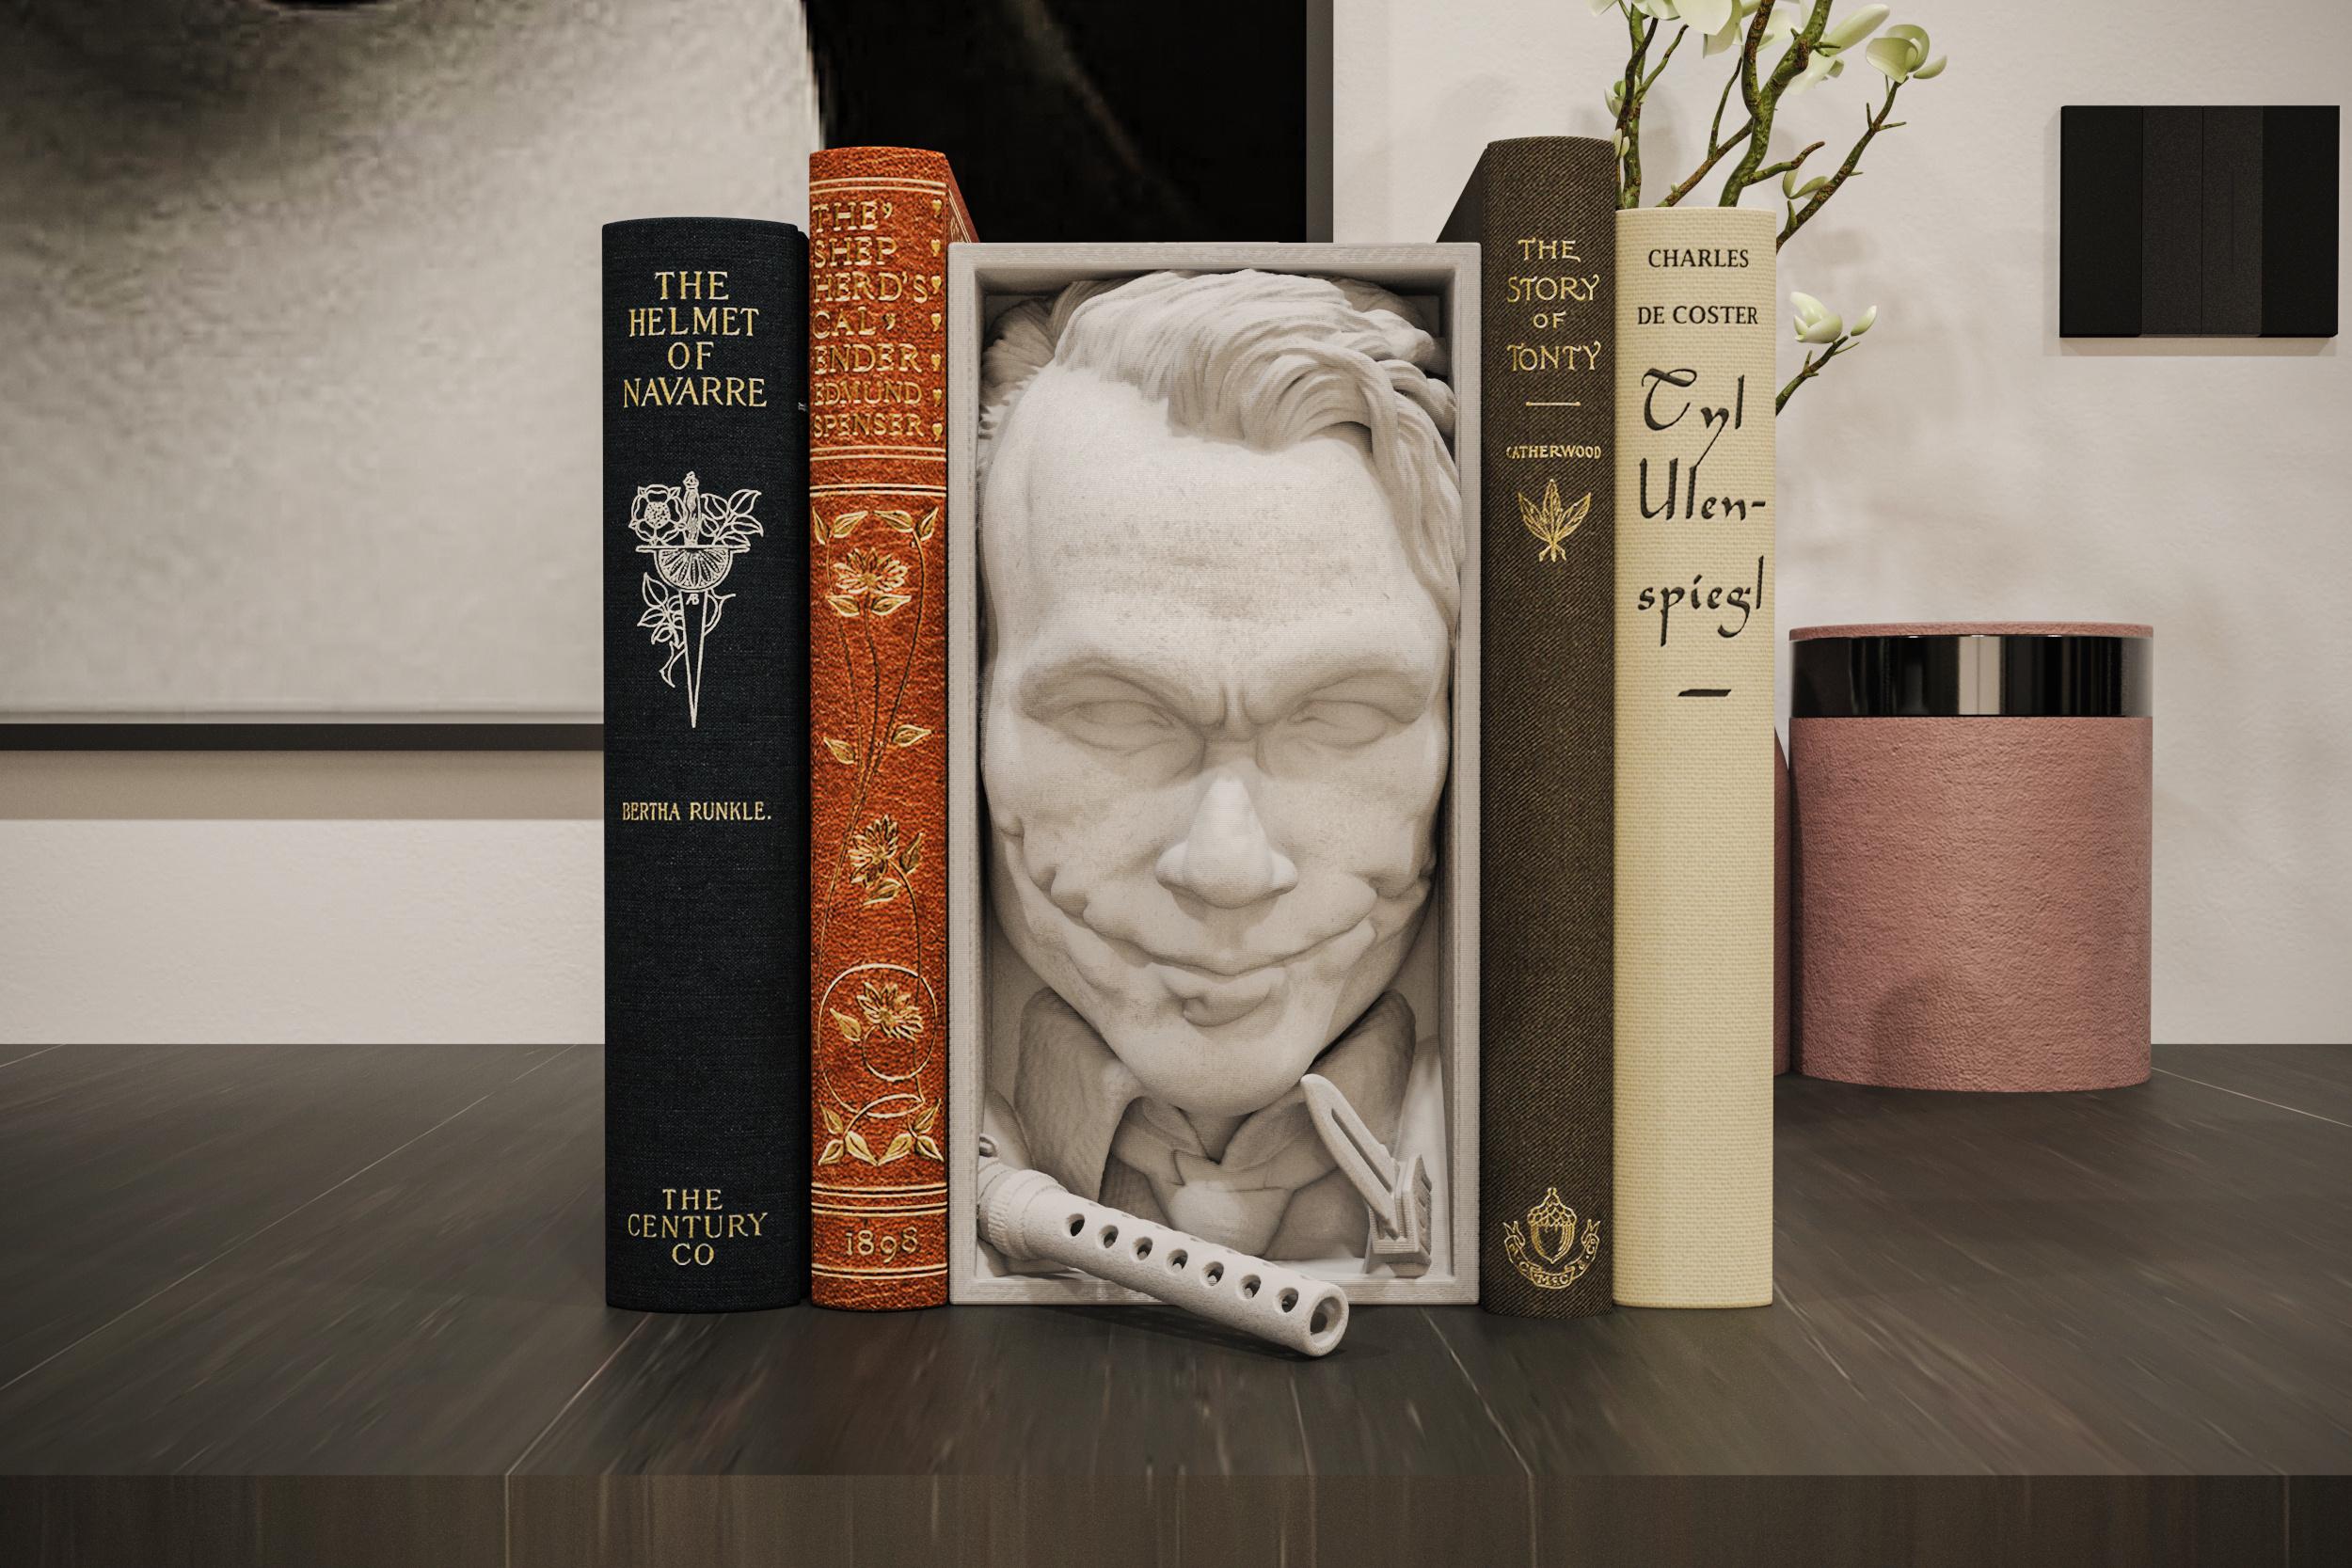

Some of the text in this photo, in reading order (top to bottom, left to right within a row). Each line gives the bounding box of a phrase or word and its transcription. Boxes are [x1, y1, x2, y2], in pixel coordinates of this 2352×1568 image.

[812, 200, 879, 233] THE
[813, 236, 898, 269] SHEP
[1518, 237, 1581, 262] THE
[1647, 248, 1750, 268] CHARLES
[654, 270, 730, 300] THE
[813, 271, 929, 304] HERD'S
[1507, 274, 1600, 303] STORY
[628, 306, 760, 338] HELMET
[812, 306, 877, 340] CAL
[1533, 310, 1566, 329] OF
[1638, 306, 1758, 325] DE COSTER
[667, 341, 715, 371] OF
[814, 342, 922, 374] ENDER
[1507, 341, 1601, 372] TONTY
[623, 376, 768, 408] NAVARRE
[814, 380, 922, 406] EDMUND
[813, 413, 925, 438] SPENSER
[1505, 444, 1601, 459] CATHERWOOD
[1639, 457, 1766, 520] Ulen-
[1637, 555, 1764, 647] spiegl
[622, 800, 772, 821] BERTHA RUNKLE.
[662, 1188, 723, 1212] THE
[628, 1212, 768, 1240] CENTURY
[671, 1243, 715, 1266] CO
[845, 1226, 919, 1264] 1898
